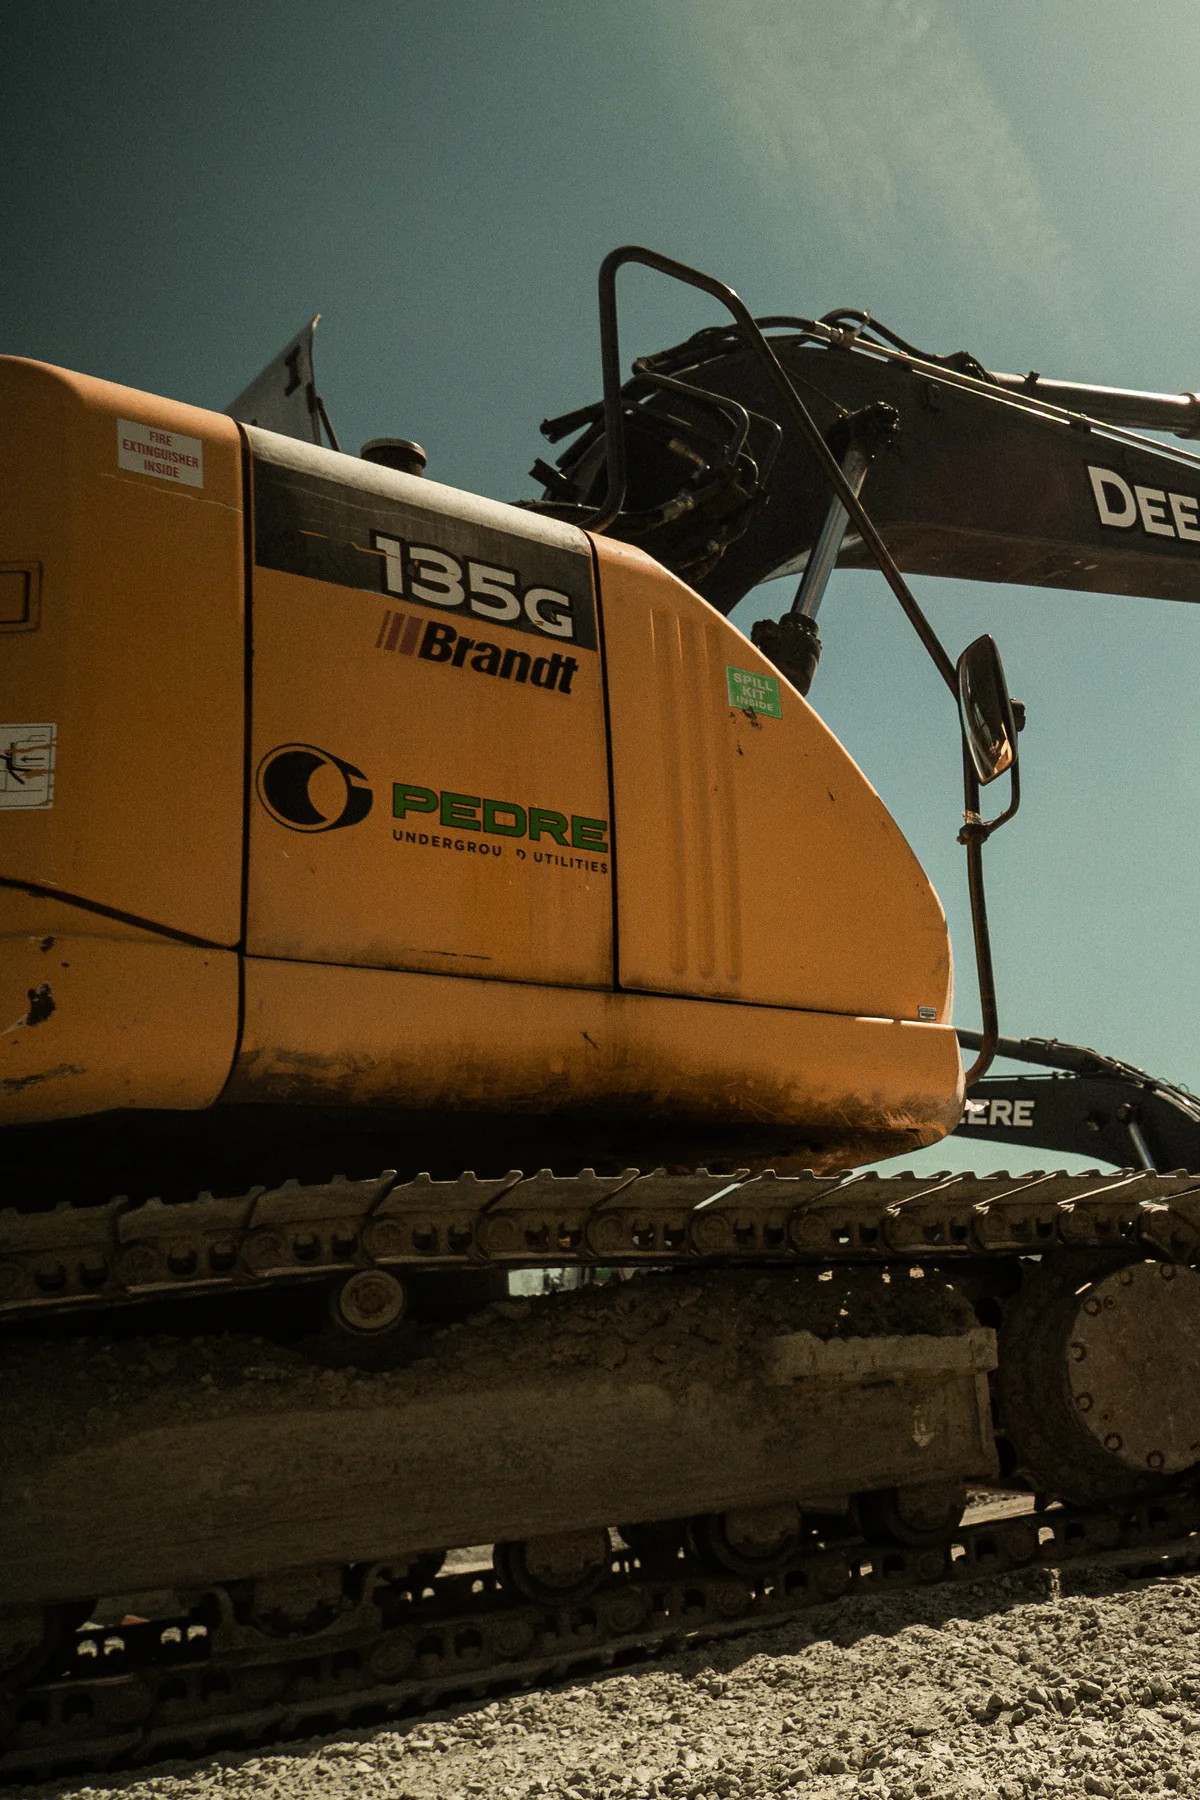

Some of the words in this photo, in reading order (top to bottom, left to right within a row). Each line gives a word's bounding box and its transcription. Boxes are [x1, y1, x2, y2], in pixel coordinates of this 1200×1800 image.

[149, 430, 173, 447] FIRE
[122, 439, 199, 468] EXTINGUISHER
[143, 459, 181, 478] INSIDE
[375, 535, 574, 638] 135G
[418, 620, 579, 695] Brandt
[733, 672, 773, 692] SPILL
[742, 686, 766, 700] KIT
[736, 696, 774, 711] INSIDE
[392, 782, 609, 853] PEDRE
[392, 828, 526, 860] UNDERGROUD
[533, 851, 609, 874] UTILITIES
[959, 1098, 1035, 1127] ERE
